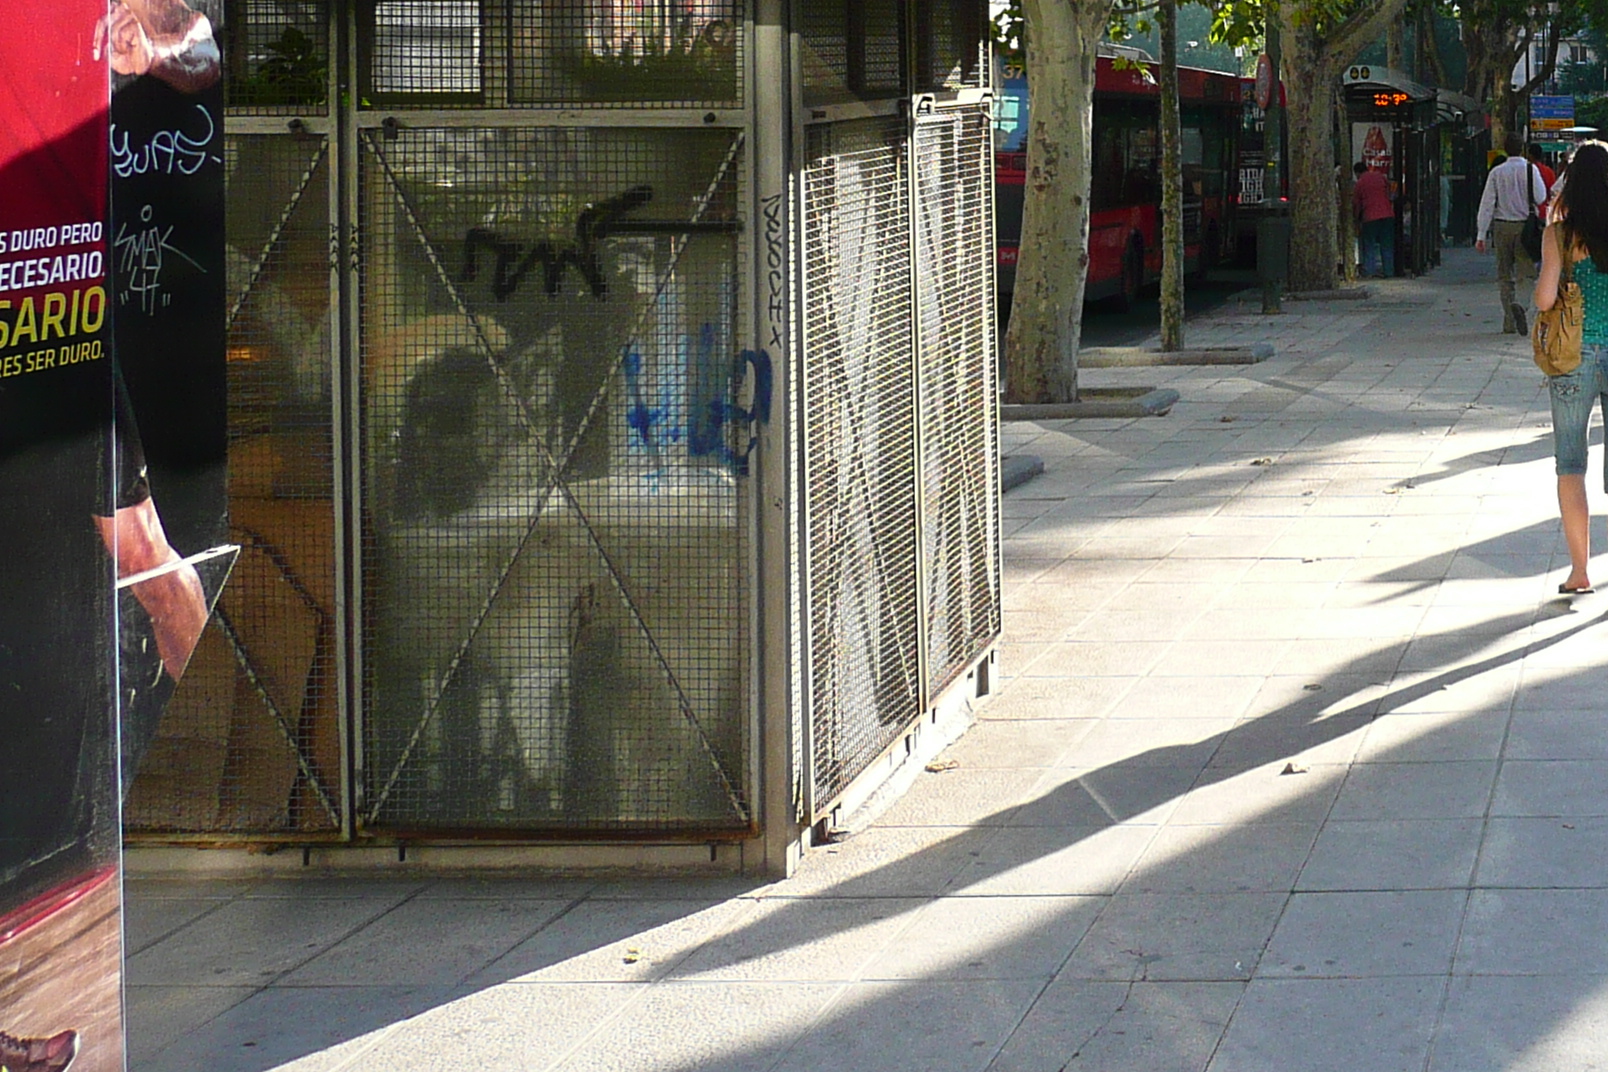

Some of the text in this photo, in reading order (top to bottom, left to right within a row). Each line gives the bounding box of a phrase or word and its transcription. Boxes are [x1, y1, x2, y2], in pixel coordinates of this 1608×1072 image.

[1003, 65, 1024, 79] 37
[10, 226, 58, 252] DURO
[60, 221, 103, 246] PERO
[0, 340, 105, 378] ES SER DURO.
